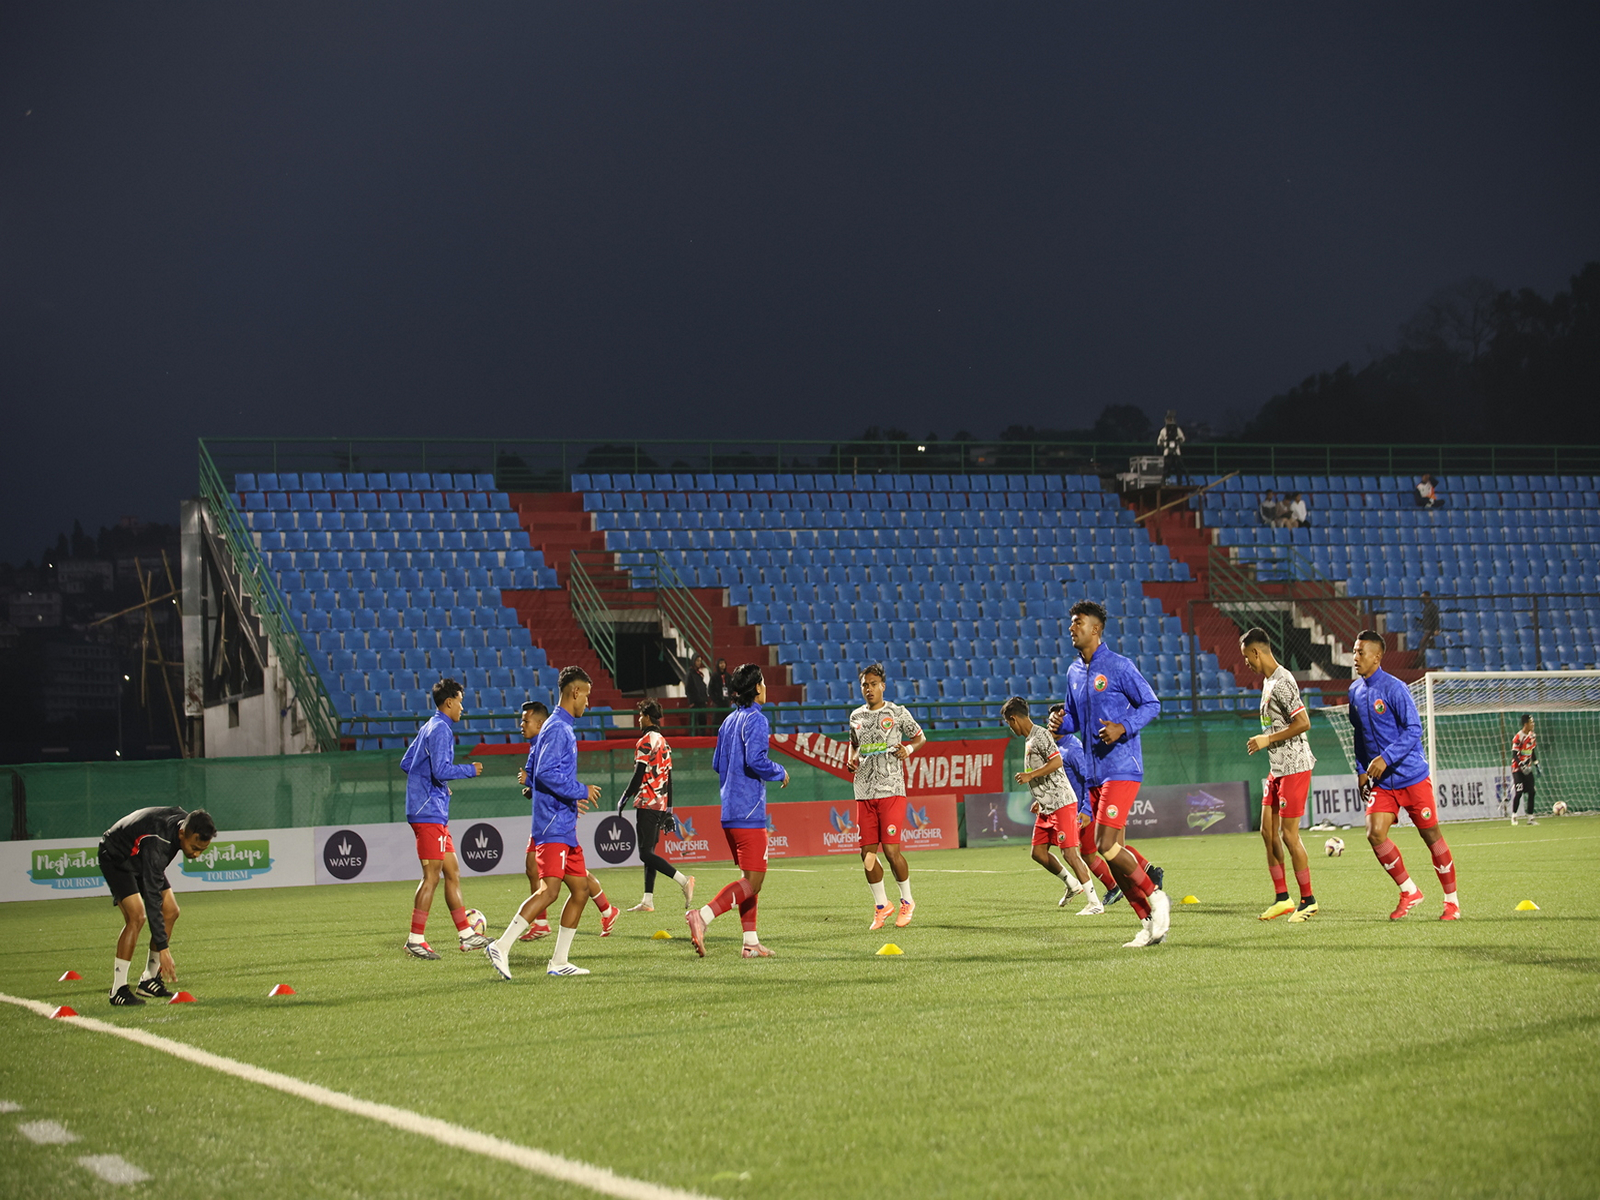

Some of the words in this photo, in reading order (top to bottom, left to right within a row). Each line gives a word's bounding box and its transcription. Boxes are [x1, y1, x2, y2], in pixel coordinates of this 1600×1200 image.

[1313, 788, 1342, 815] THE
[1437, 783, 1448, 808] S
[1451, 781, 1485, 807] BLUE
[823, 832, 860, 846] KINGFISH
[900, 828, 943, 842] KINGFISHER
[600, 842, 631, 852] WAVES
[664, 840, 709, 855] KINGFISHER
[187, 843, 264, 870] eghalaya
[466, 849, 499, 860] WAVES
[36, 850, 100, 876] Meghala
[329, 857, 362, 867] WAVES
[56, 877, 99, 888] TOURISM
[206, 870, 249, 881] TOURISM
